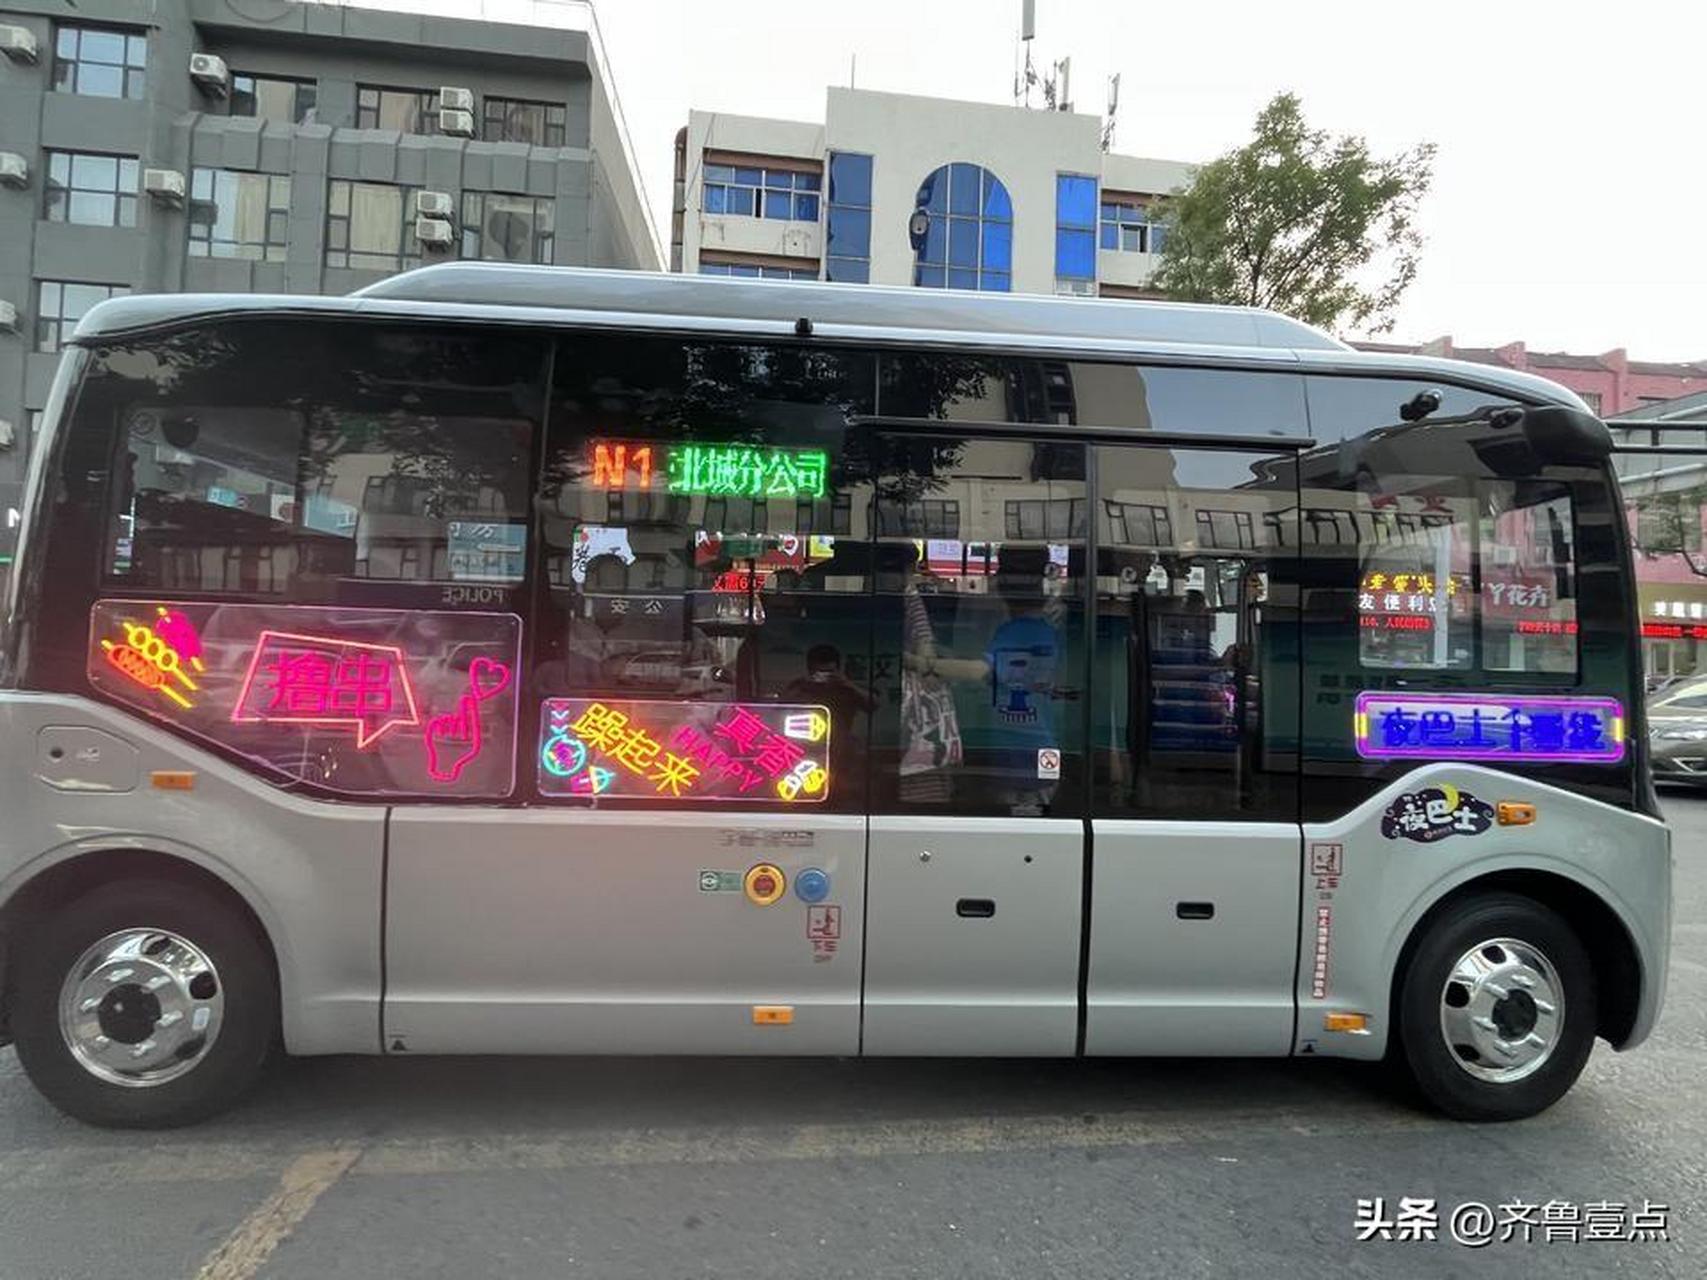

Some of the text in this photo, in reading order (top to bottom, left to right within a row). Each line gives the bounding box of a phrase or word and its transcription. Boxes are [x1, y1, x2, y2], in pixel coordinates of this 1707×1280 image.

[594, 445, 826, 498] N1 北城分公司
[266, 649, 392, 716] 撸串
[571, 702, 701, 796] 躁起来
[669, 724, 763, 793] HAPPY
[714, 706, 805, 777] 真香
[1400, 799, 1479, 833] 夜巴士
